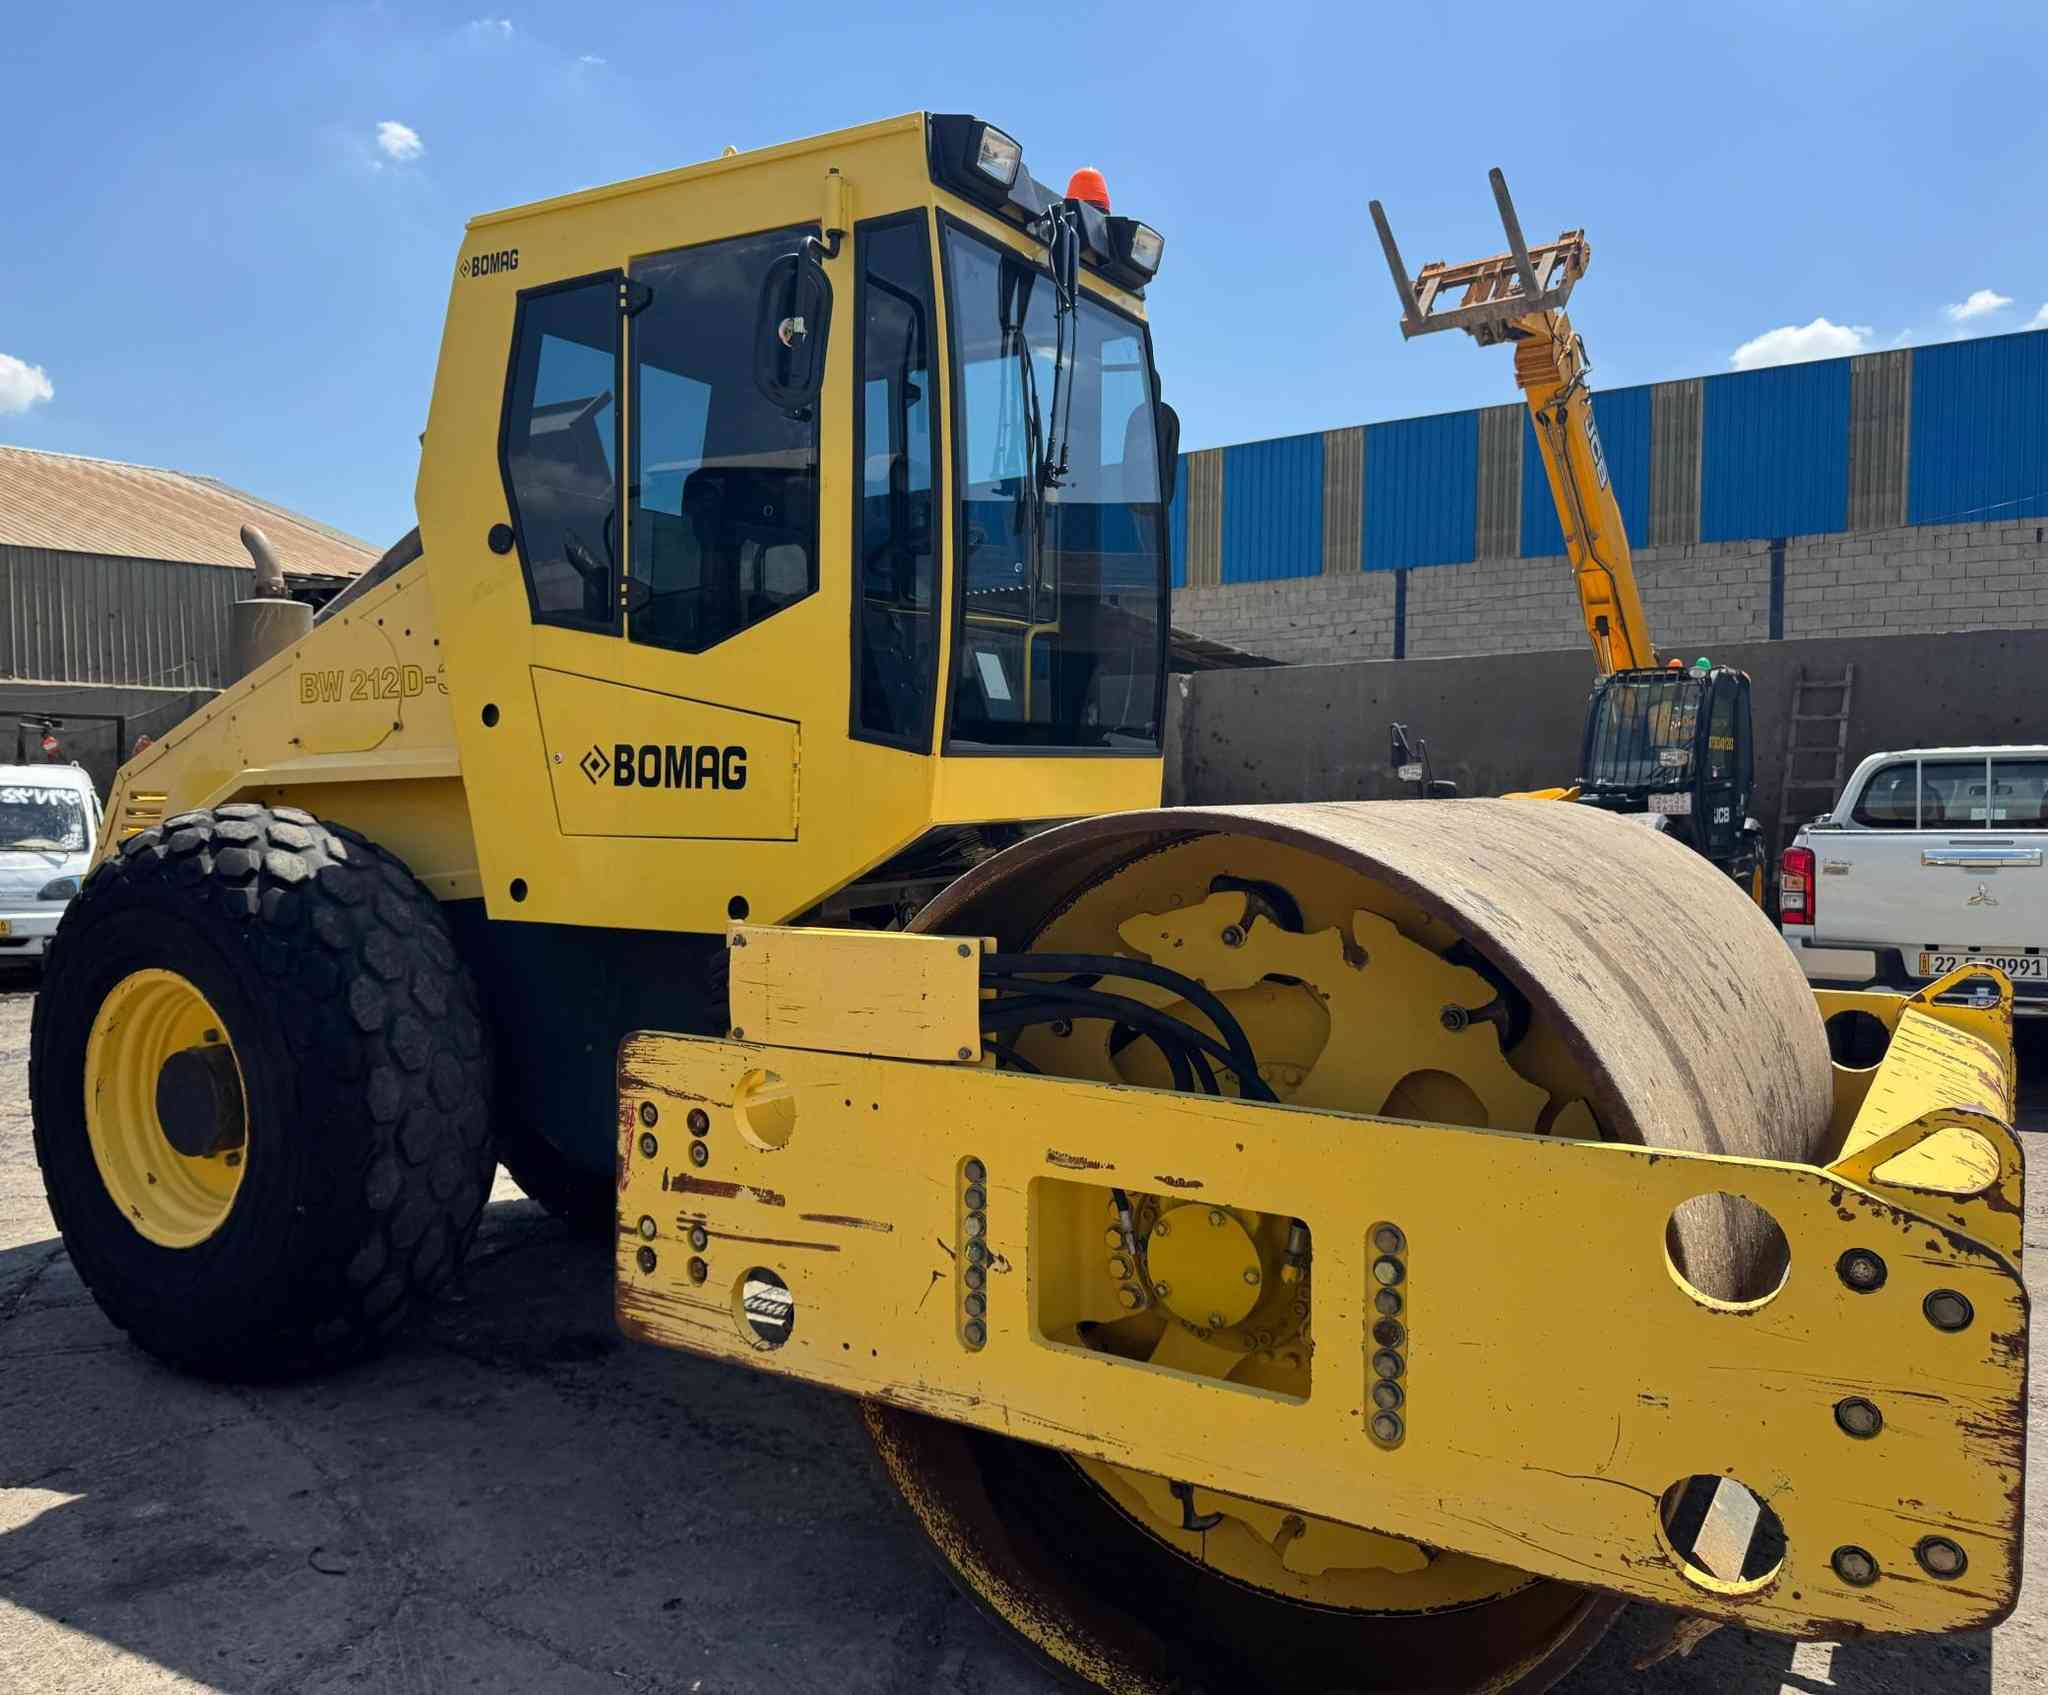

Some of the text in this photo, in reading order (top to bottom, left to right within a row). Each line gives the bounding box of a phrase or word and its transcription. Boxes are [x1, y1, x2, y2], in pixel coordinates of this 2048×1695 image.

[471, 248, 519, 277] BOMAG
[299, 669, 345, 704] BW
[613, 743, 748, 791] BOMAG
[1713, 806, 1730, 824] JCB
[1934, 956, 1957, 974] 22
